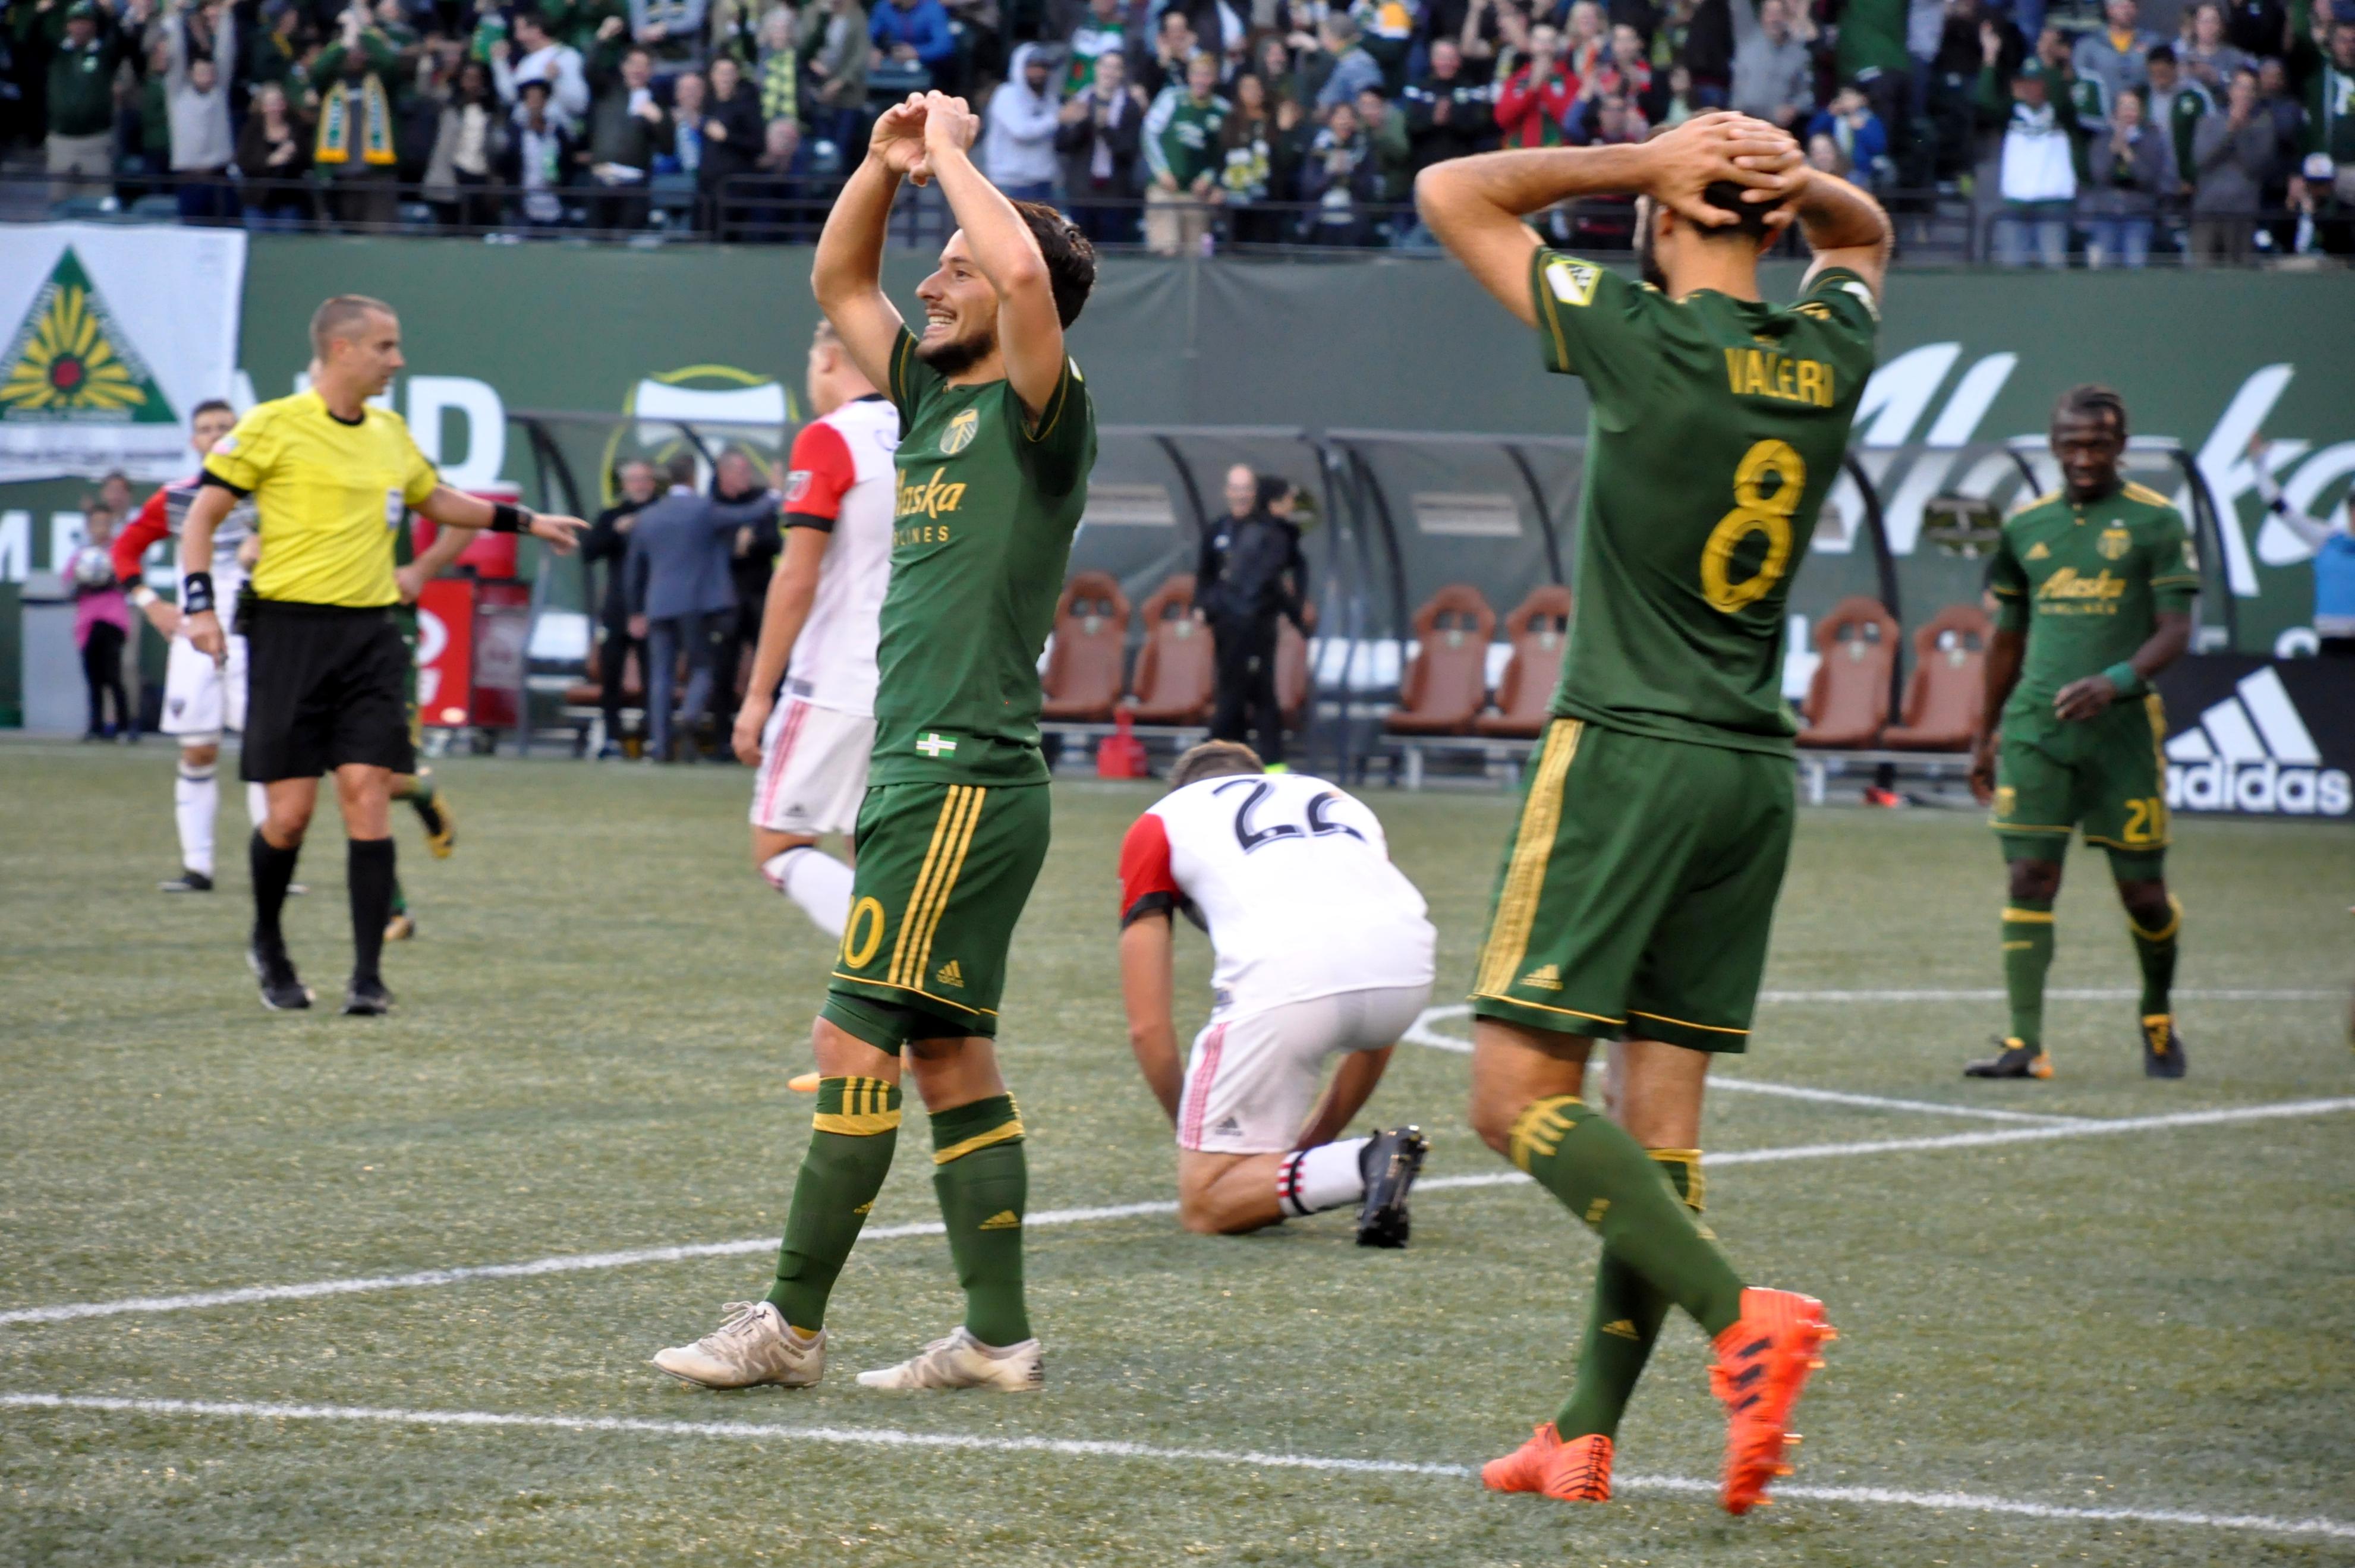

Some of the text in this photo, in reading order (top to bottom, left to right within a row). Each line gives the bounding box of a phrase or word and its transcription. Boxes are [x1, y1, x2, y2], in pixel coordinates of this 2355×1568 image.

[1725, 348, 1834, 408] VALERI
[895, 467, 967, 519] laska
[1700, 438, 1807, 613] 8
[2123, 797, 2164, 843] 21
